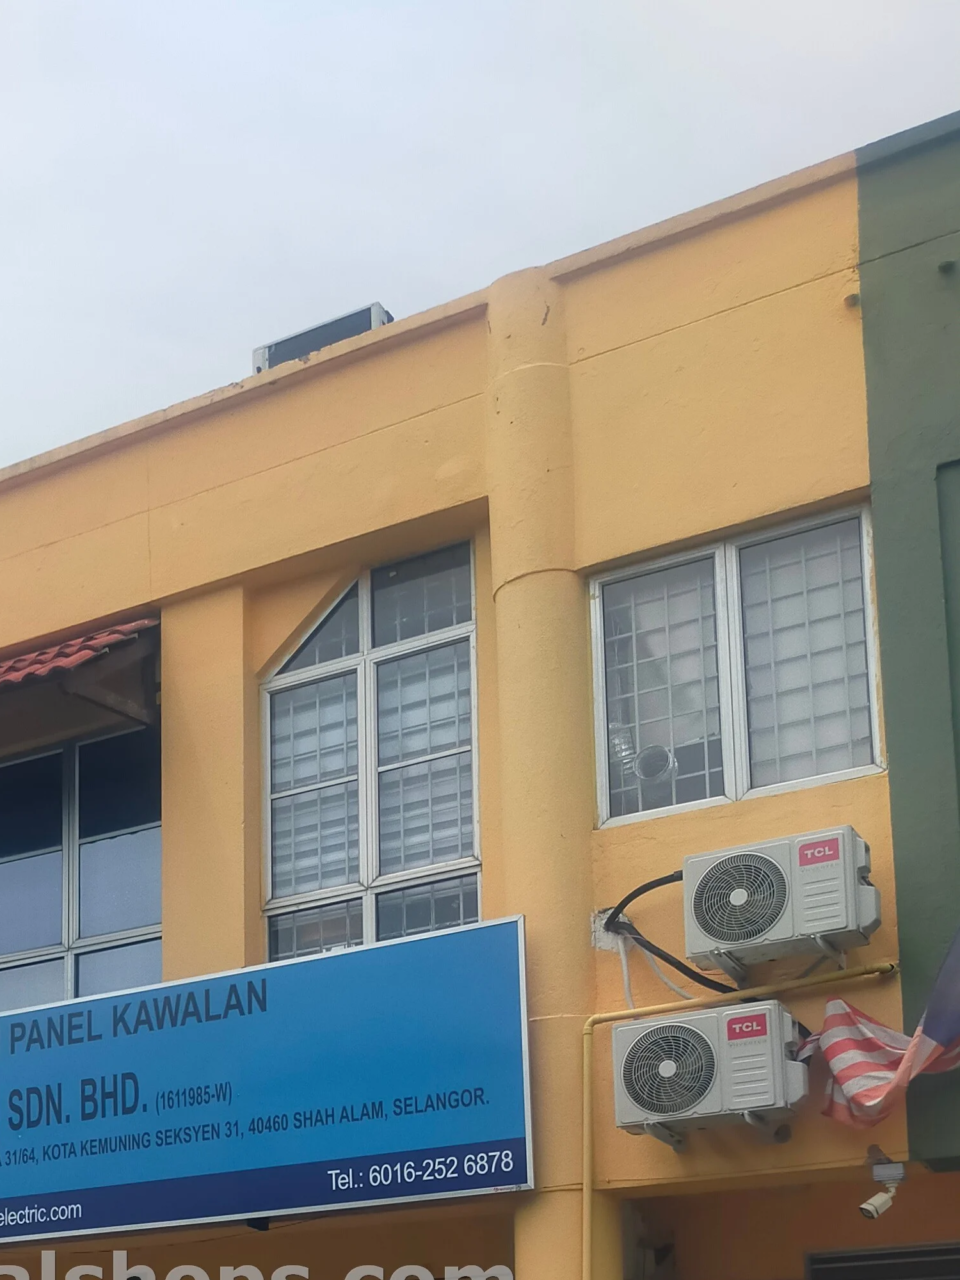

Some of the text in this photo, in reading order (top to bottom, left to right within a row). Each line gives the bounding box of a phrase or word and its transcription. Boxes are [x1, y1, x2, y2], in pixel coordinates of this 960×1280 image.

[803, 845, 834, 859] TCL
[10, 1010, 102, 1055] PANEL
[112, 978, 267, 1038] KAWALAN
[732, 1021, 761, 1033] TCL
[7, 1083, 71, 1131] SDN.
[80, 1072, 148, 1122] BHD.
[155, 1081, 233, 1116] (1611985-W)
[5, 1147, 39, 1167] 31/64,
[42, 1142, 78, 1162] KOTA
[80, 1131, 152, 1158] KEMUNING
[155, 1120, 221, 1146] SEKSYEN
[224, 1119, 245, 1140] 31,
[248, 1113, 289, 1135] 40460
[292, 1107, 335, 1130] SHAH
[339, 1101, 388, 1124] ALAM,
[392, 1087, 491, 1116] SELANGOR.
[327, 1150, 513, 1191] Tel.: 6016-252 6878
